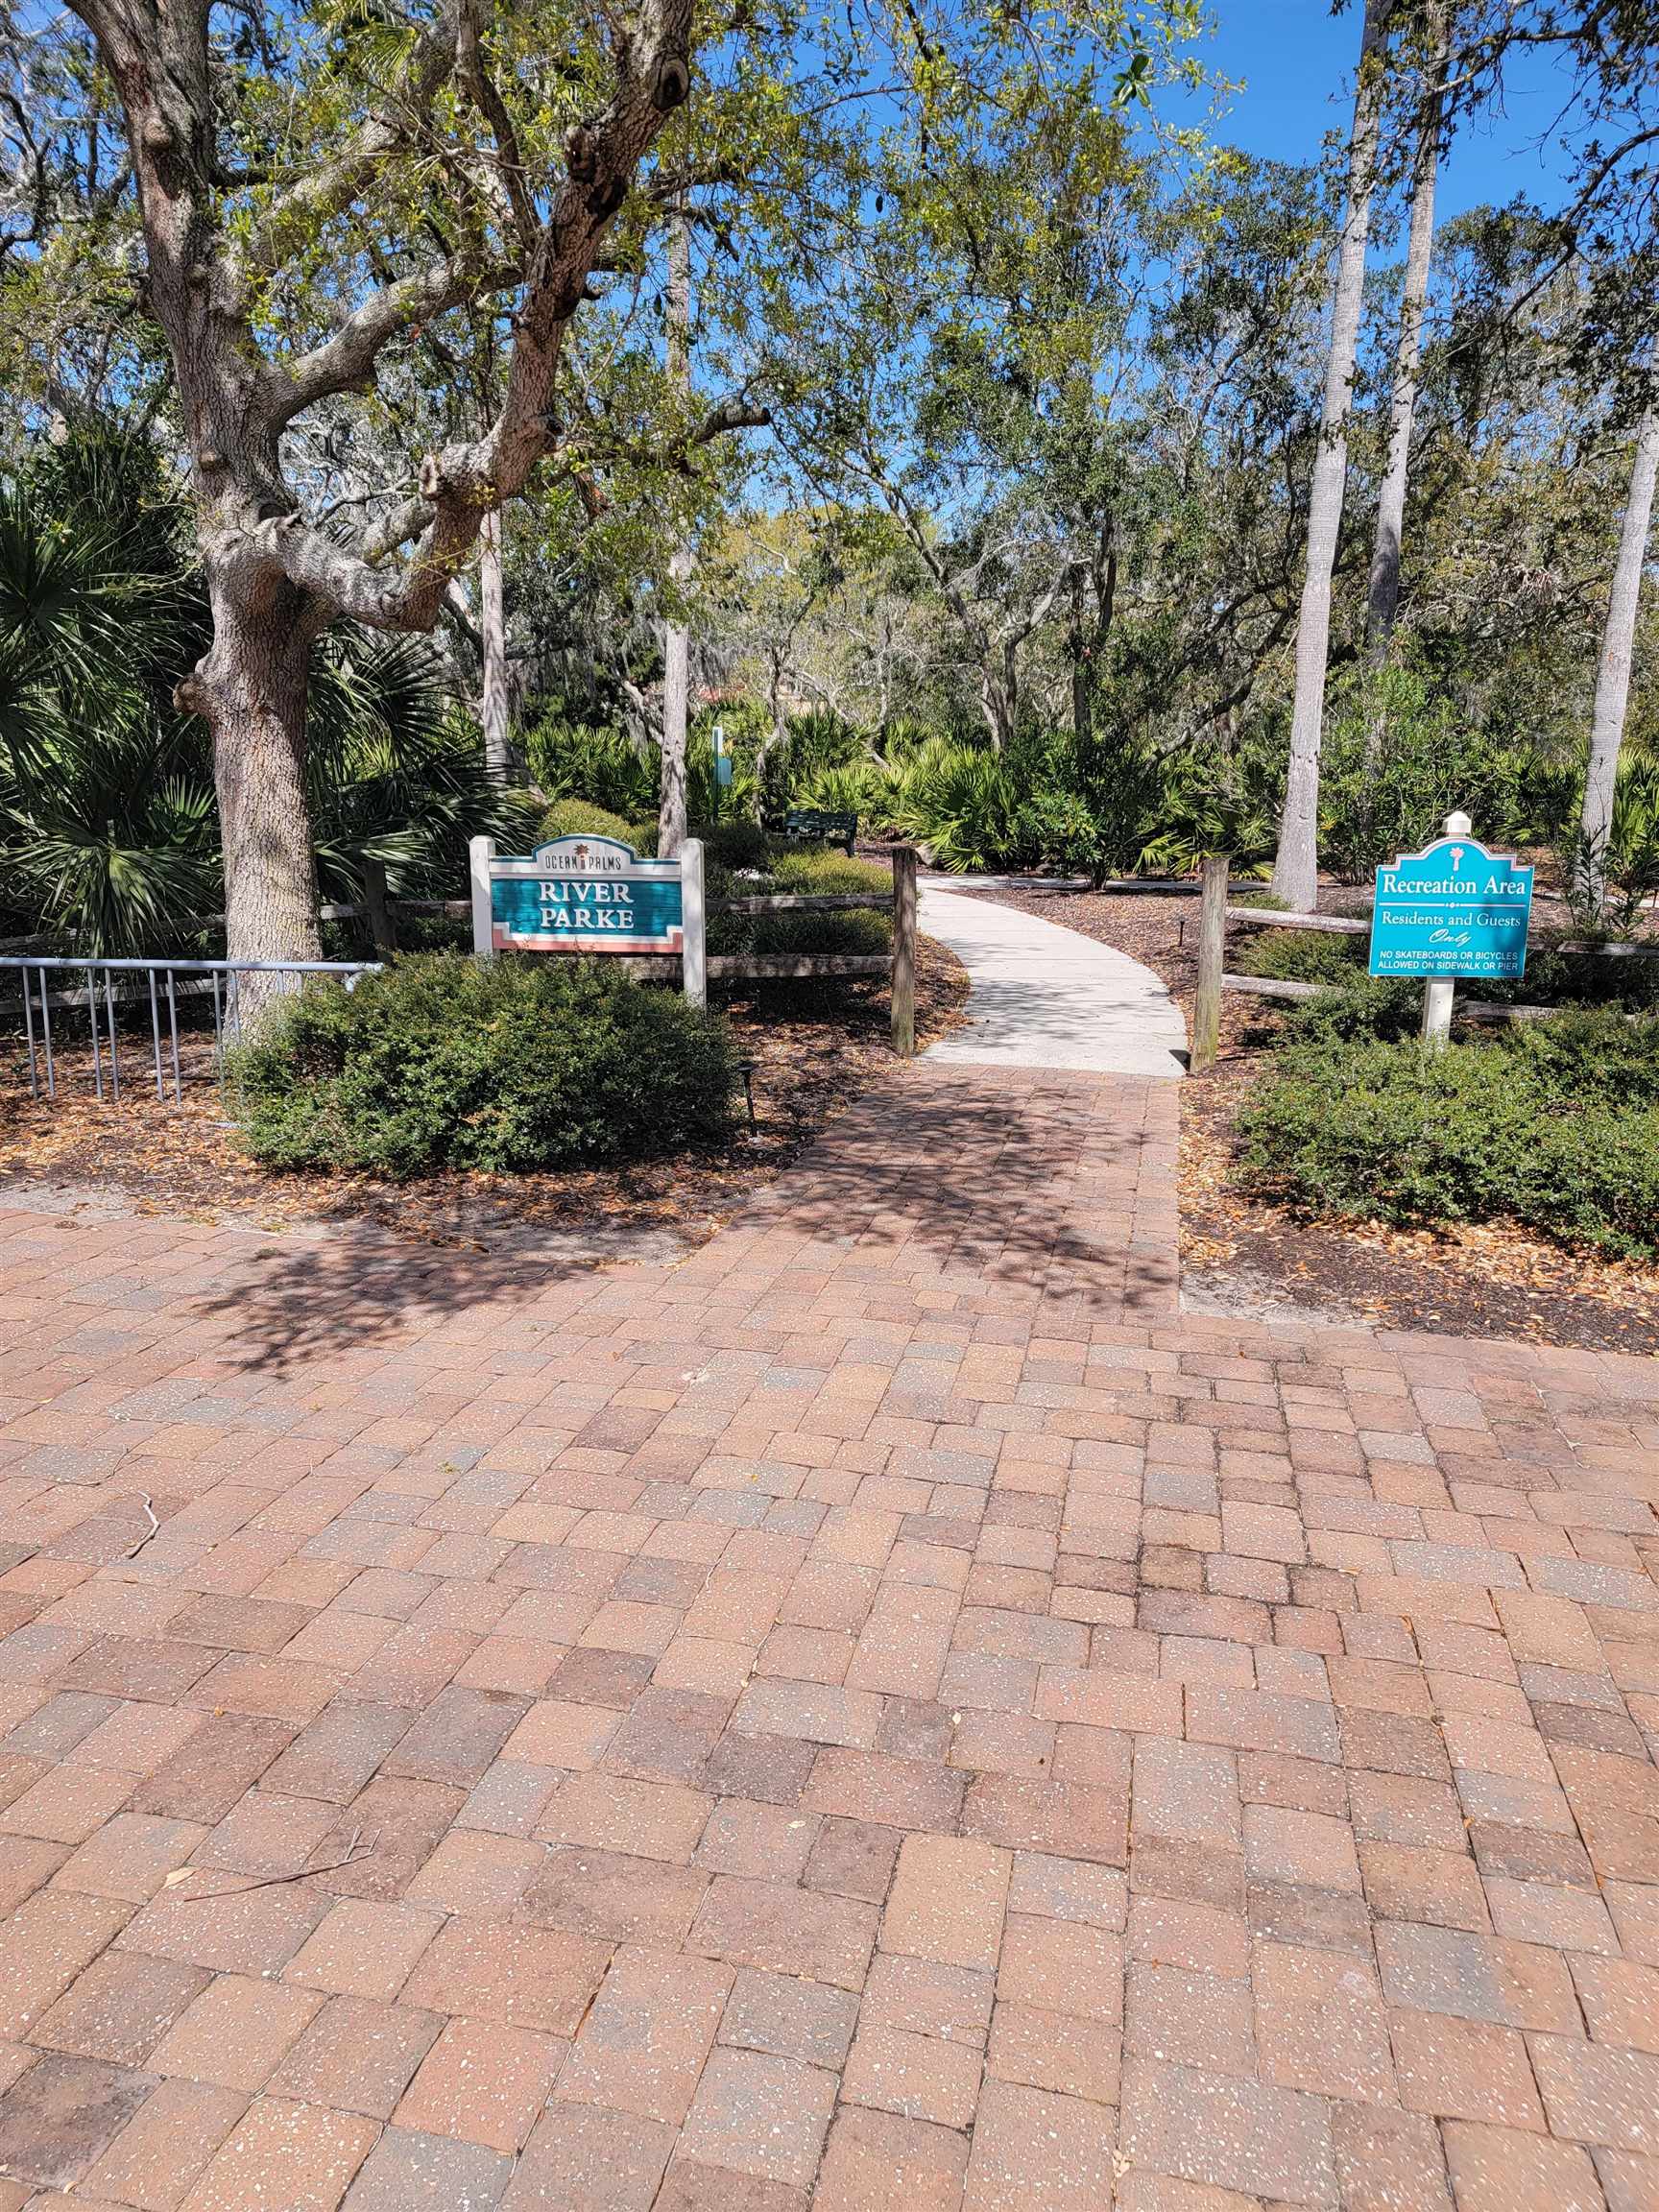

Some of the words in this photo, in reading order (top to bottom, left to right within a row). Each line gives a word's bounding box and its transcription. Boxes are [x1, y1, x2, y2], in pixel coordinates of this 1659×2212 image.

[544, 854, 576, 869] OCEAN
[589, 855, 621, 870] PALMS
[539, 881, 634, 903] RIVER
[1382, 874, 1477, 894] Recreation
[1482, 876, 1526, 895] Area
[540, 907, 634, 929] PARKE
[1382, 911, 1444, 926] Residents
[1448, 912, 1472, 926] and
[1477, 913, 1521, 926] Guests
[1429, 928, 1472, 948] Only
[1380, 950, 1393, 959] NO
[1395, 950, 1457, 960] SKATEBOARDS
[1460, 951, 1473, 960] OR
[1476, 951, 1518, 960] BICYCLES
[1378, 960, 1419, 969] ALLOWED
[1421, 961, 1434, 970] ON
[1436, 961, 1480, 970] SIDEWALK
[1482, 961, 1496, 970] OR
[1498, 962, 1518, 971] PIER
